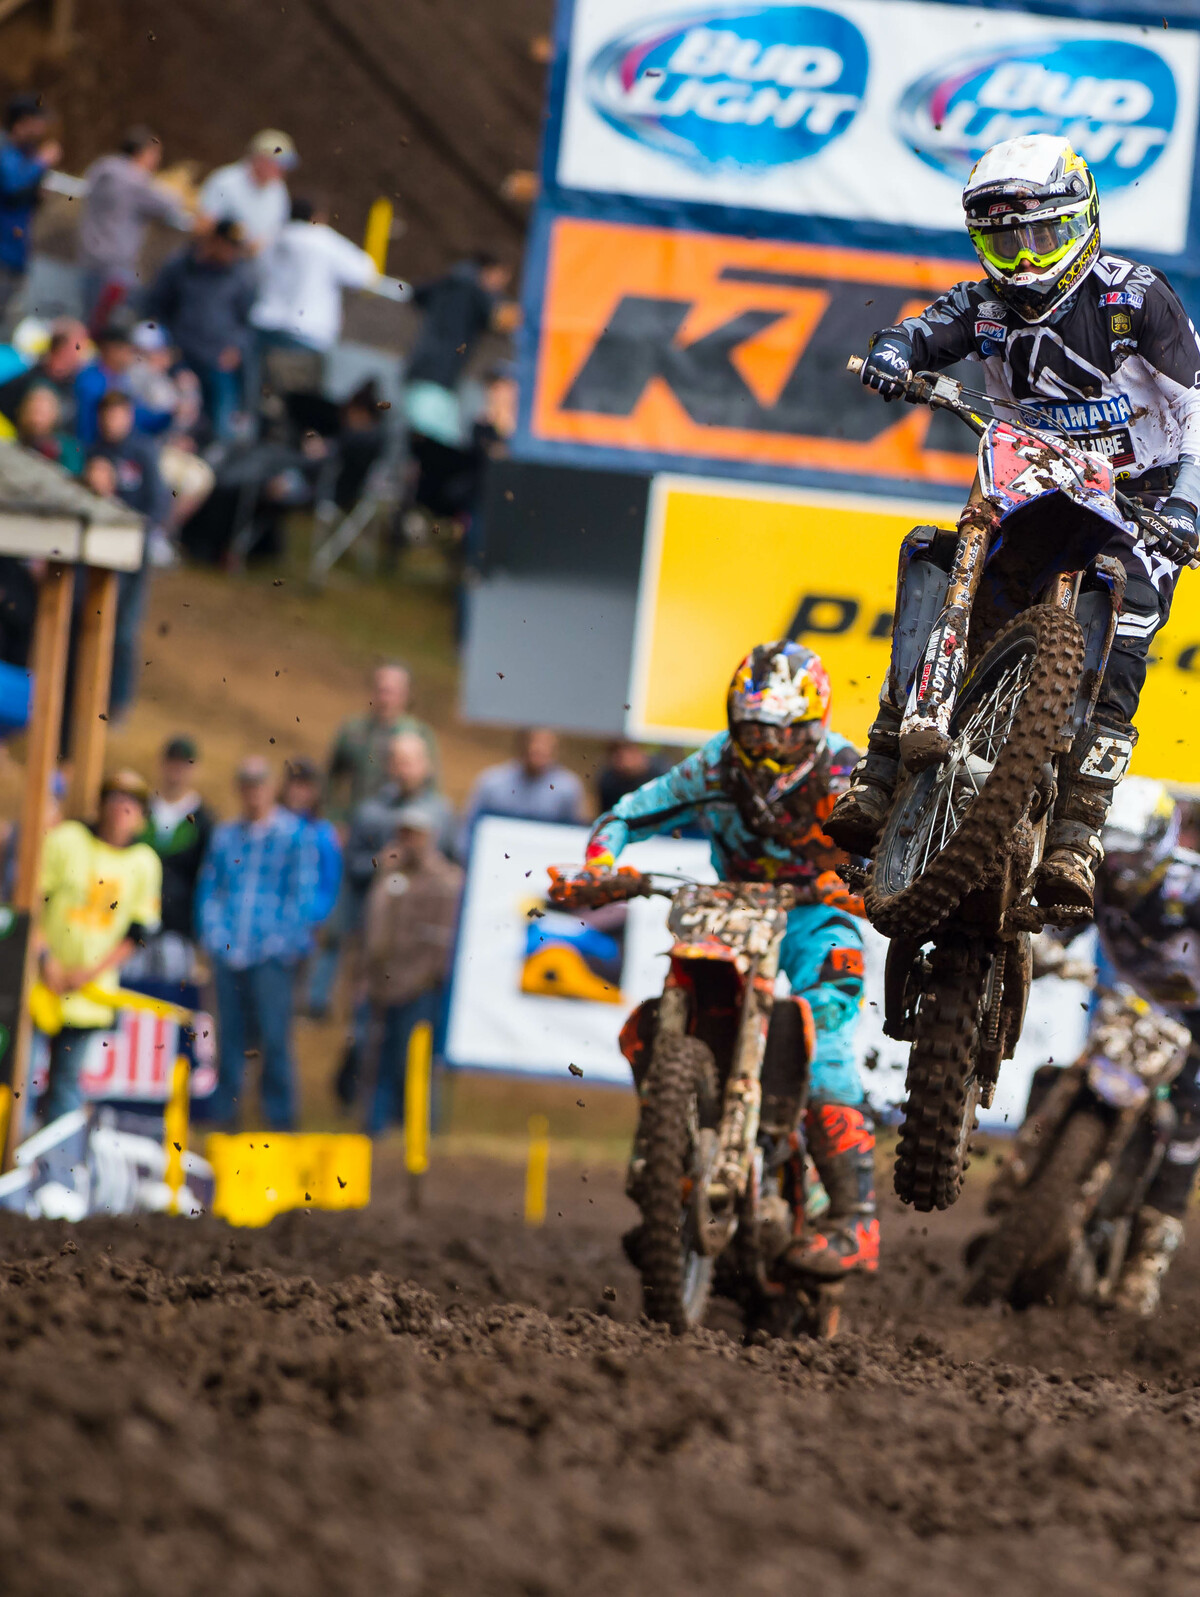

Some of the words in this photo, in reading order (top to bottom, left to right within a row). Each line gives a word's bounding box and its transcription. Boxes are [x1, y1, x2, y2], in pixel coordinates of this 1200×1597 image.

[668, 26, 844, 88] BUD
[630, 68, 860, 135] LIGHT
[976, 61, 1154, 122] BUD
[559, 265, 985, 456] KT
[978, 323, 1003, 338] 100%
[1040, 396, 1132, 428] YAMAHA
